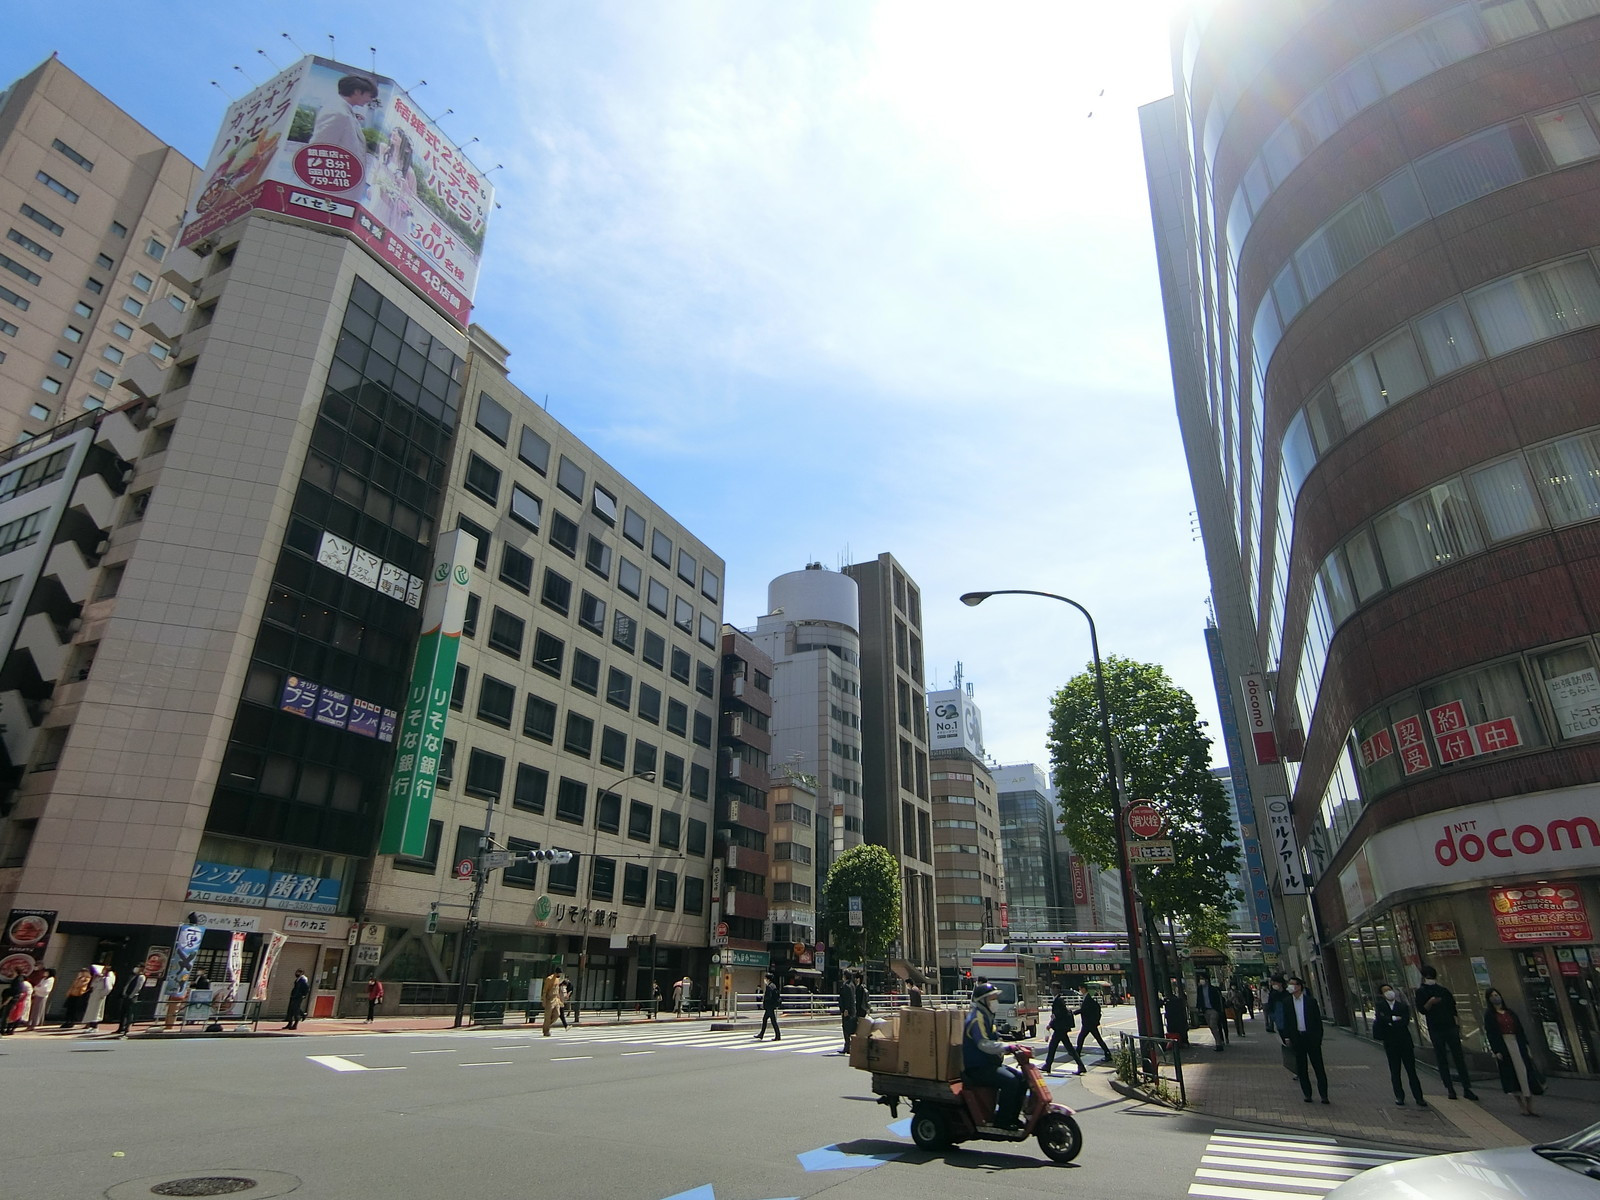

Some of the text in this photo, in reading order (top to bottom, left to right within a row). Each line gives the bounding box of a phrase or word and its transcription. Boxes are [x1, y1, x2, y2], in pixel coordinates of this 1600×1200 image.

[310, 176, 350, 187] 759-418
[328, 538, 423, 590] ヘッドマッサージ
[381, 579, 418, 606] 専門店
[286, 686, 364, 723] プラスワン
[1247, 679, 1264, 728] docomo
[1560, 683, 1598, 699] こちらに
[936, 721, 958, 731] No.1
[394, 686, 426, 796] りそな銀行
[416, 688, 447, 799] りそな銀行
[1131, 814, 1159, 828] 消火栓
[1453, 820, 1477, 833] NTT
[1275, 825, 1300, 888] ルノアール
[191, 863, 244, 885] レンガ
[268, 874, 321, 900] 歯科
[194, 891, 211, 900] 入口
[556, 903, 618, 928] りそな銀行
